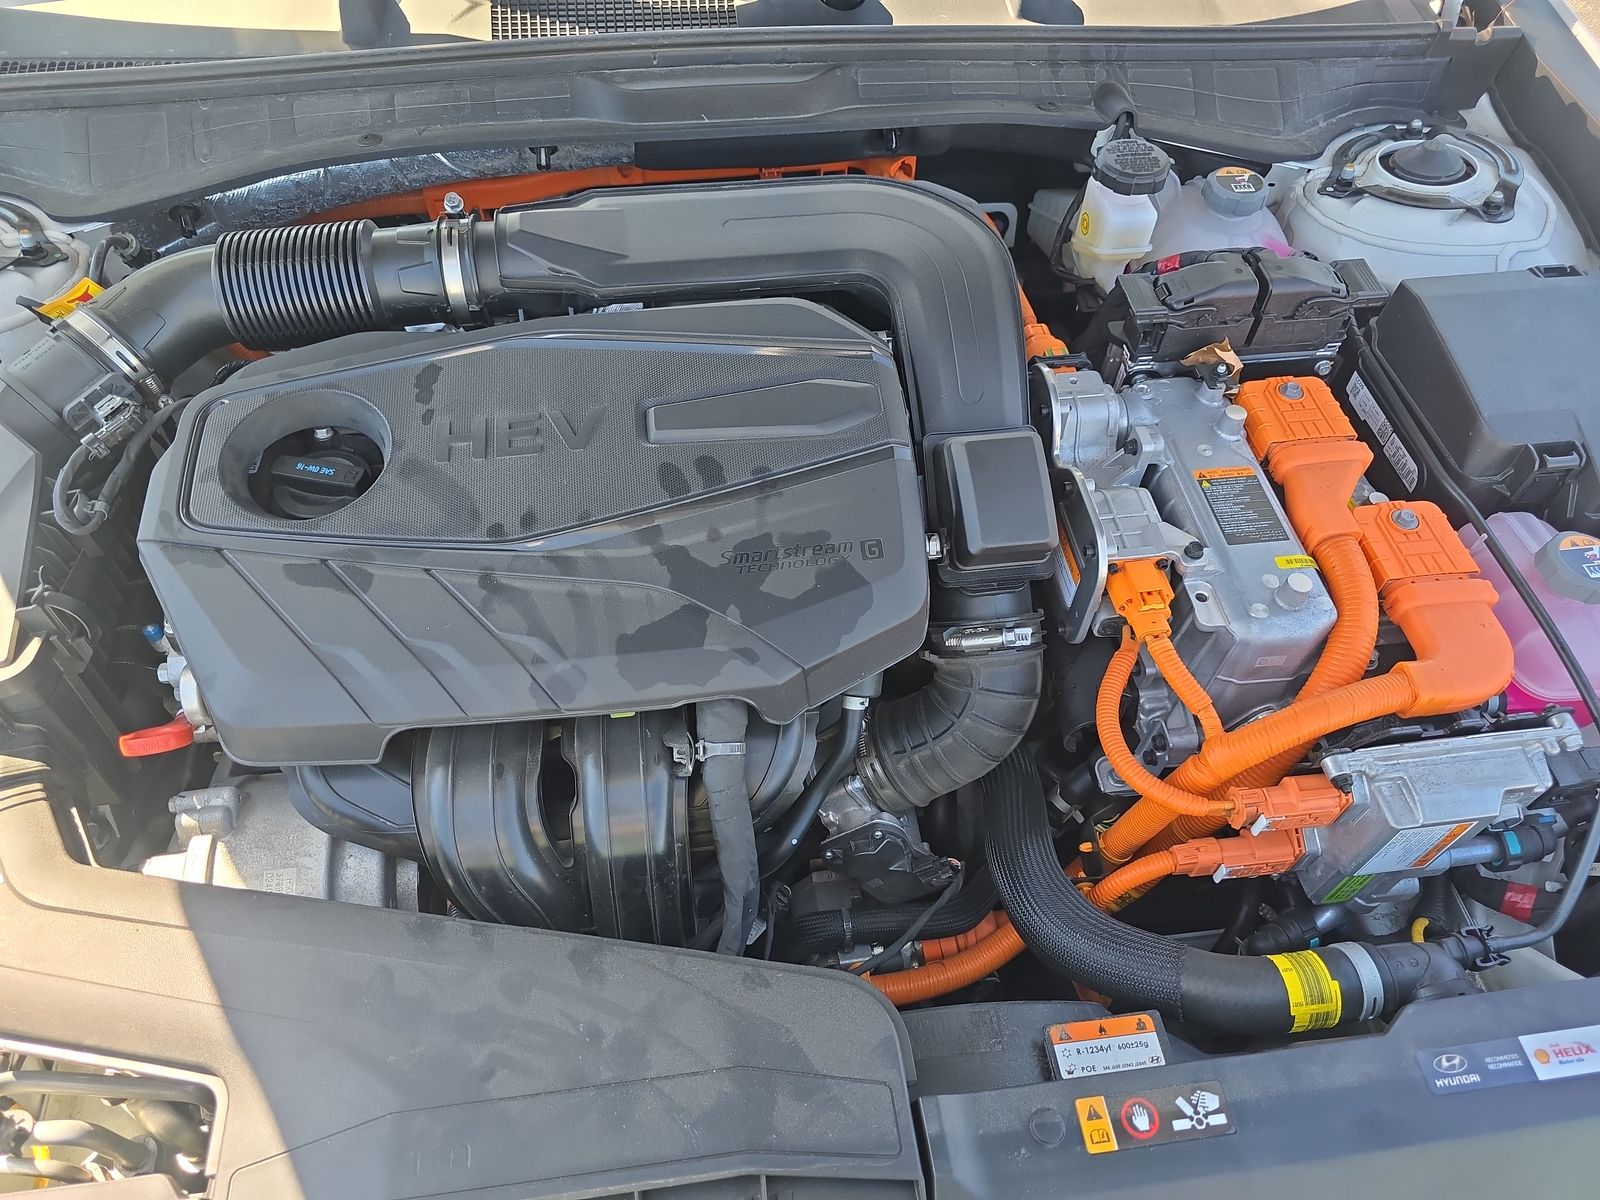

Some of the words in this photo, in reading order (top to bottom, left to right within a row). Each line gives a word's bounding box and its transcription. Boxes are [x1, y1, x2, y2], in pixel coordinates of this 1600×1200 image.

[435, 405, 607, 463] HEV
[296, 463, 320, 473] 0W-16
[320, 467, 336, 476] SAE
[720, 541, 853, 566] Smartstream
[736, 554, 851, 575] TECHNOLOGY
[1076, 1043, 1112, 1057] R-1234yf
[1117, 1040, 1149, 1051] 600±25g
[1554, 1043, 1597, 1059] HELIX
[1081, 1064, 1098, 1073] POE
[1434, 1073, 1481, 1088] HYUNDAI
